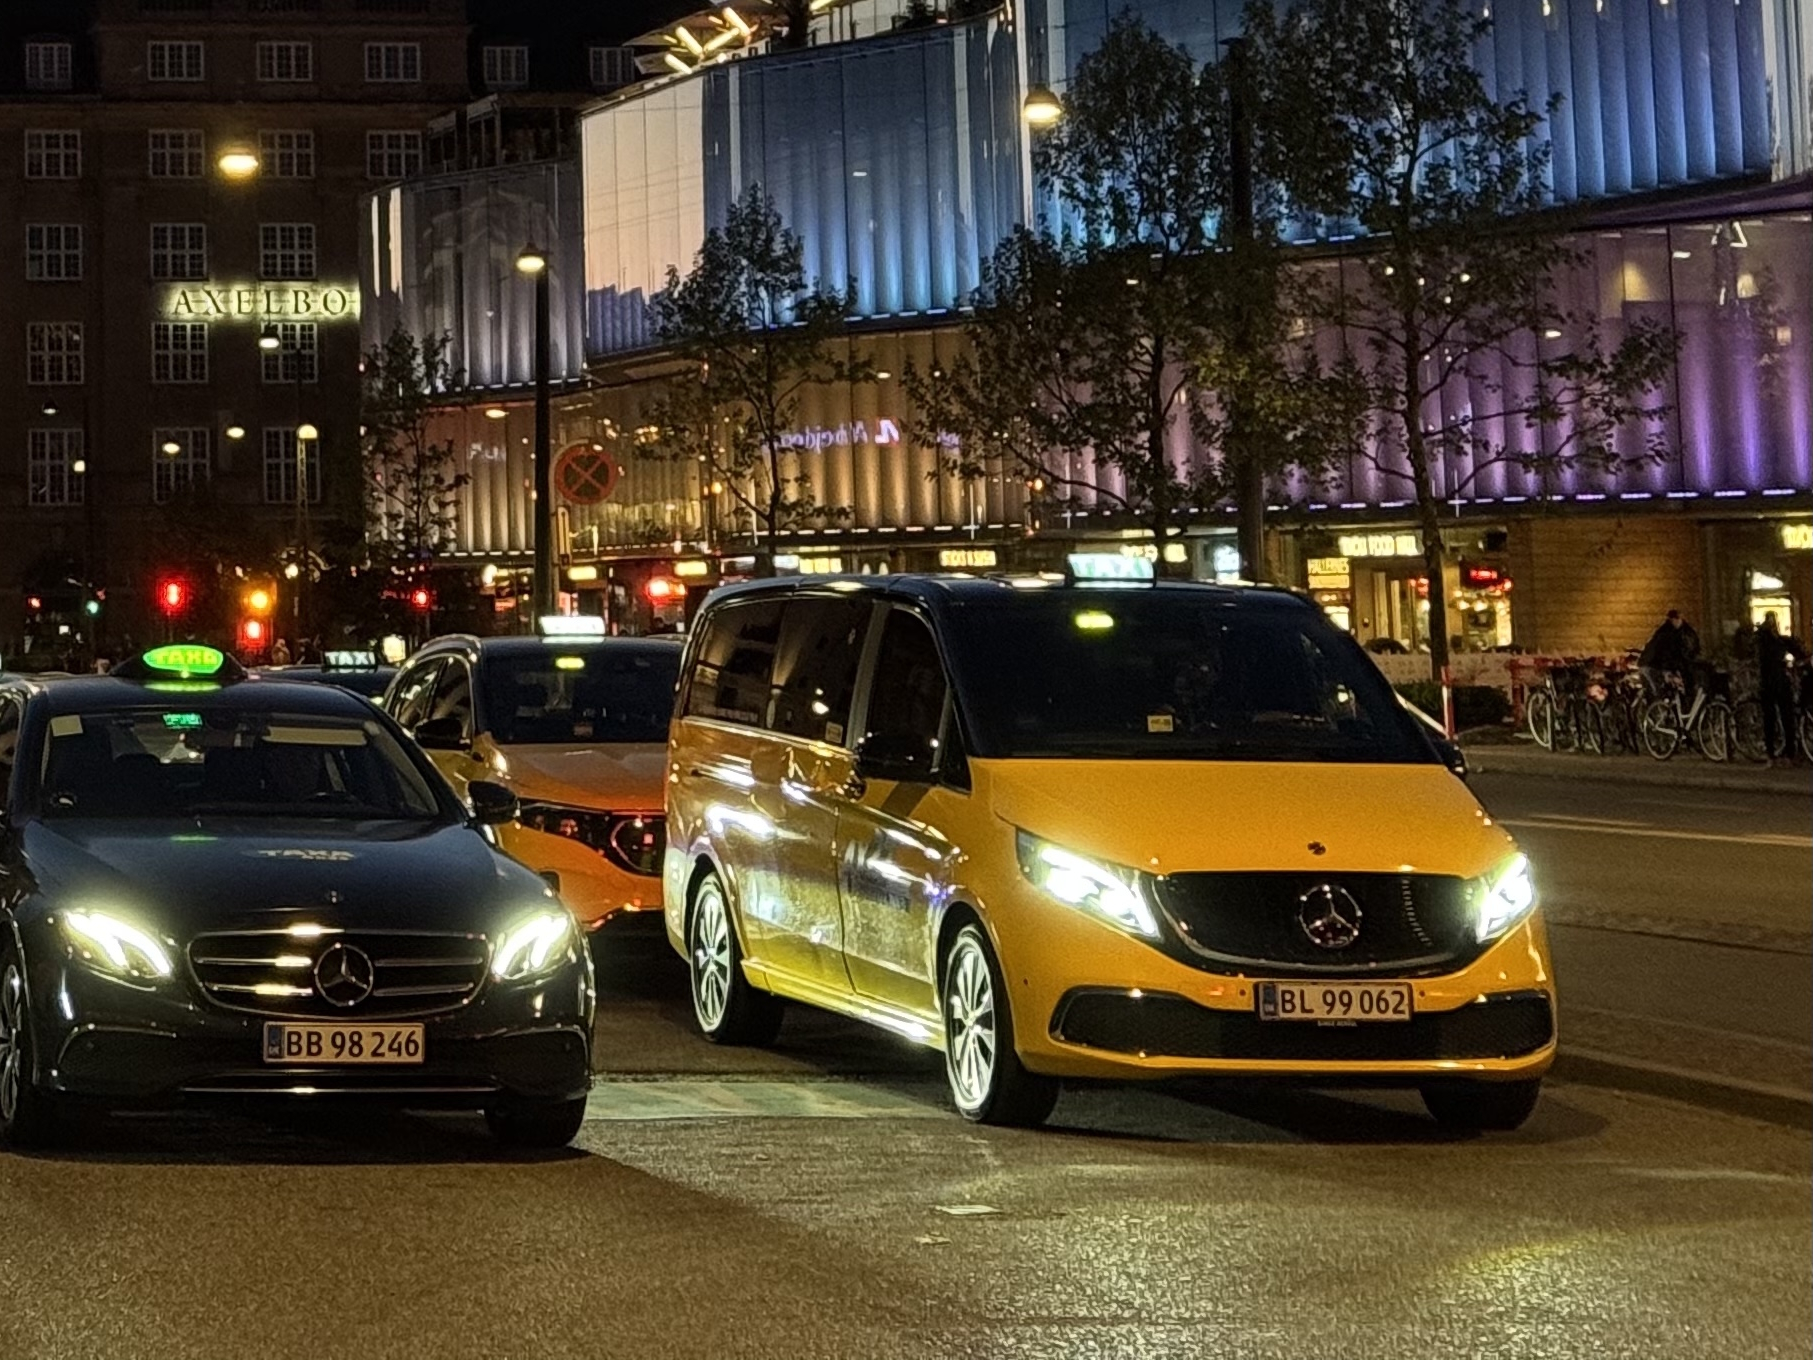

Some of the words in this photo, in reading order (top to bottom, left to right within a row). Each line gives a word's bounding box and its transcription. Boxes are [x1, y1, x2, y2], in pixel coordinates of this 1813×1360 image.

[325, 651, 374, 666] TAXI
[1281, 989, 1314, 1014] BL
[1322, 990, 1353, 1015] 99
[1359, 990, 1405, 1015] 062
[287, 1030, 323, 1057] BB
[331, 1030, 363, 1058] 98
[370, 1030, 419, 1058] 246
